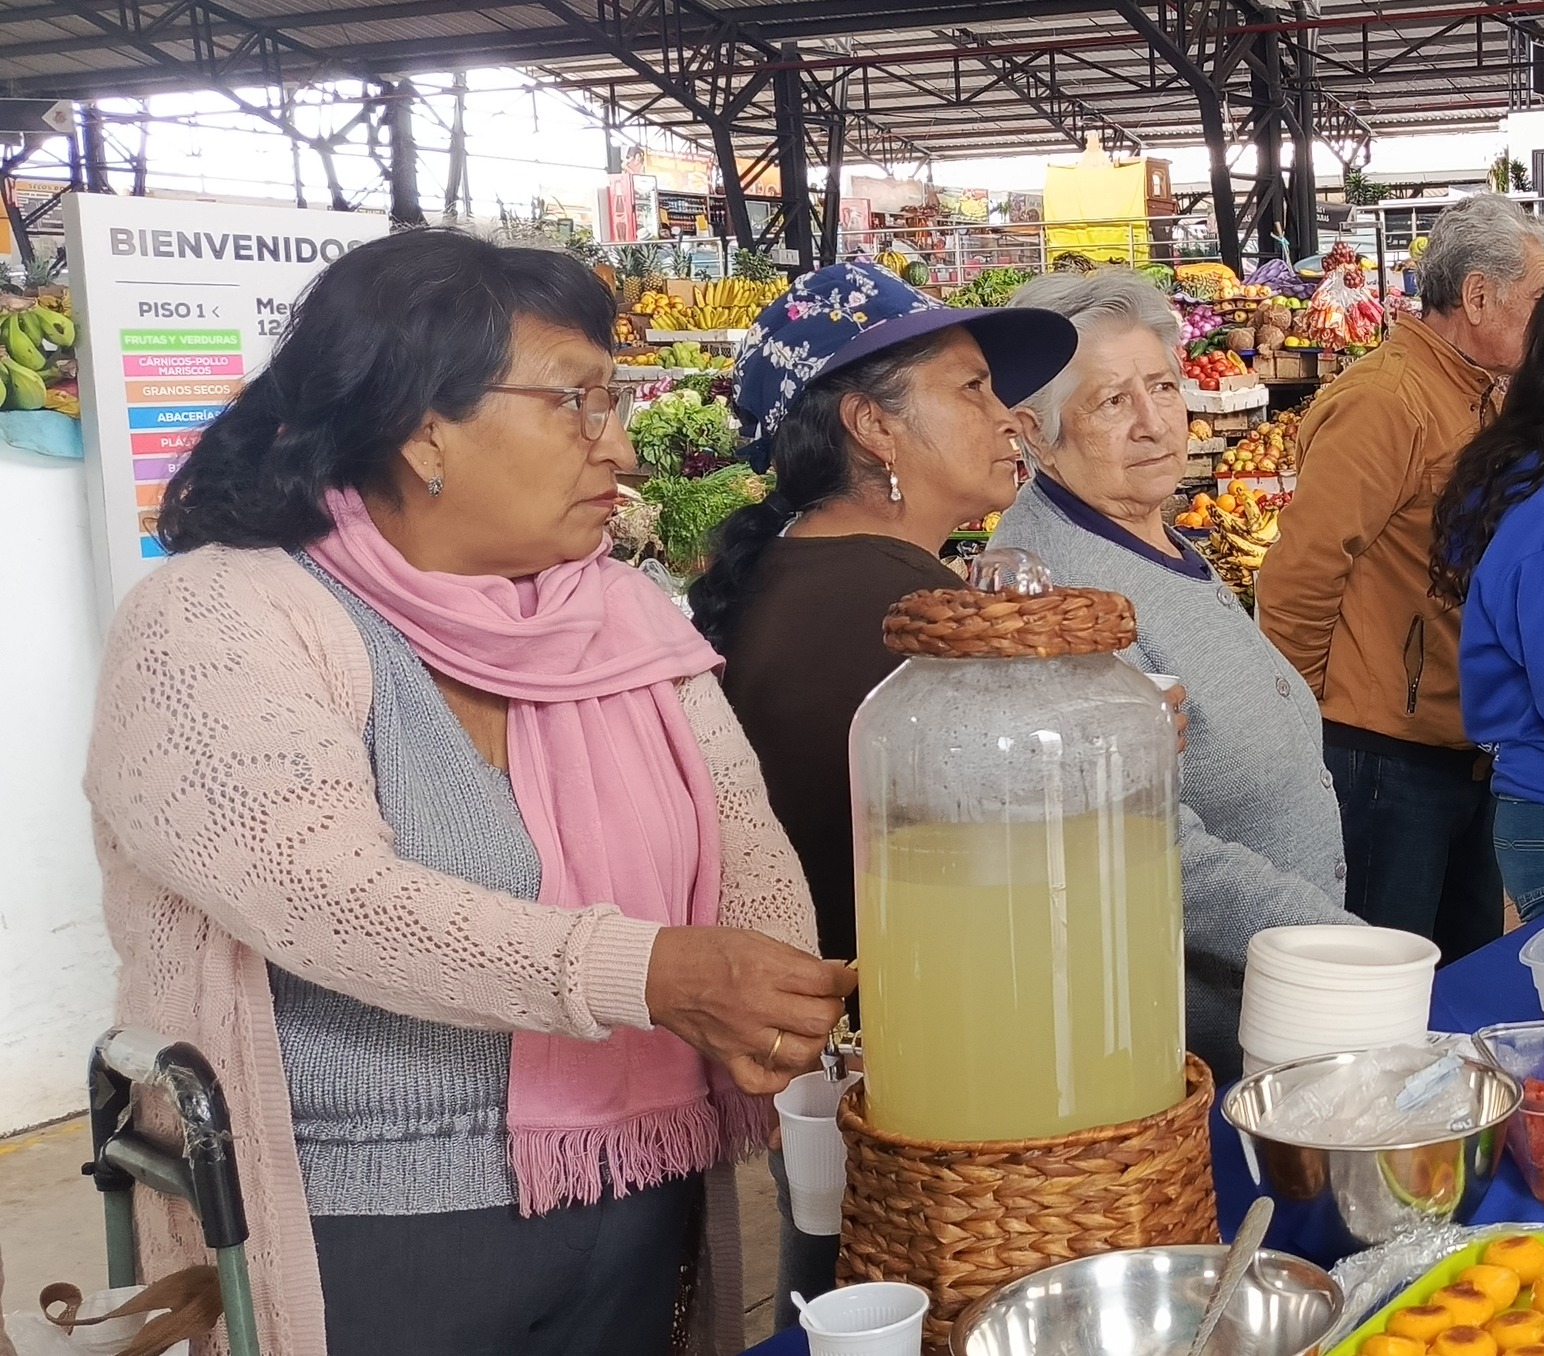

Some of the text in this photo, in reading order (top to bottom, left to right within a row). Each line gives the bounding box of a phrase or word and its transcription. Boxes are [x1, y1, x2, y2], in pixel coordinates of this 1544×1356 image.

[138, 301, 206, 318] PISO 1
[124, 335, 238, 345] FRUTAS Y VERDURAS
[138, 356, 229, 366] CÁRNICOS-POLLO
[158, 367, 212, 376] MARISCOS
[142, 384, 231, 396] GRANOS SECOS
